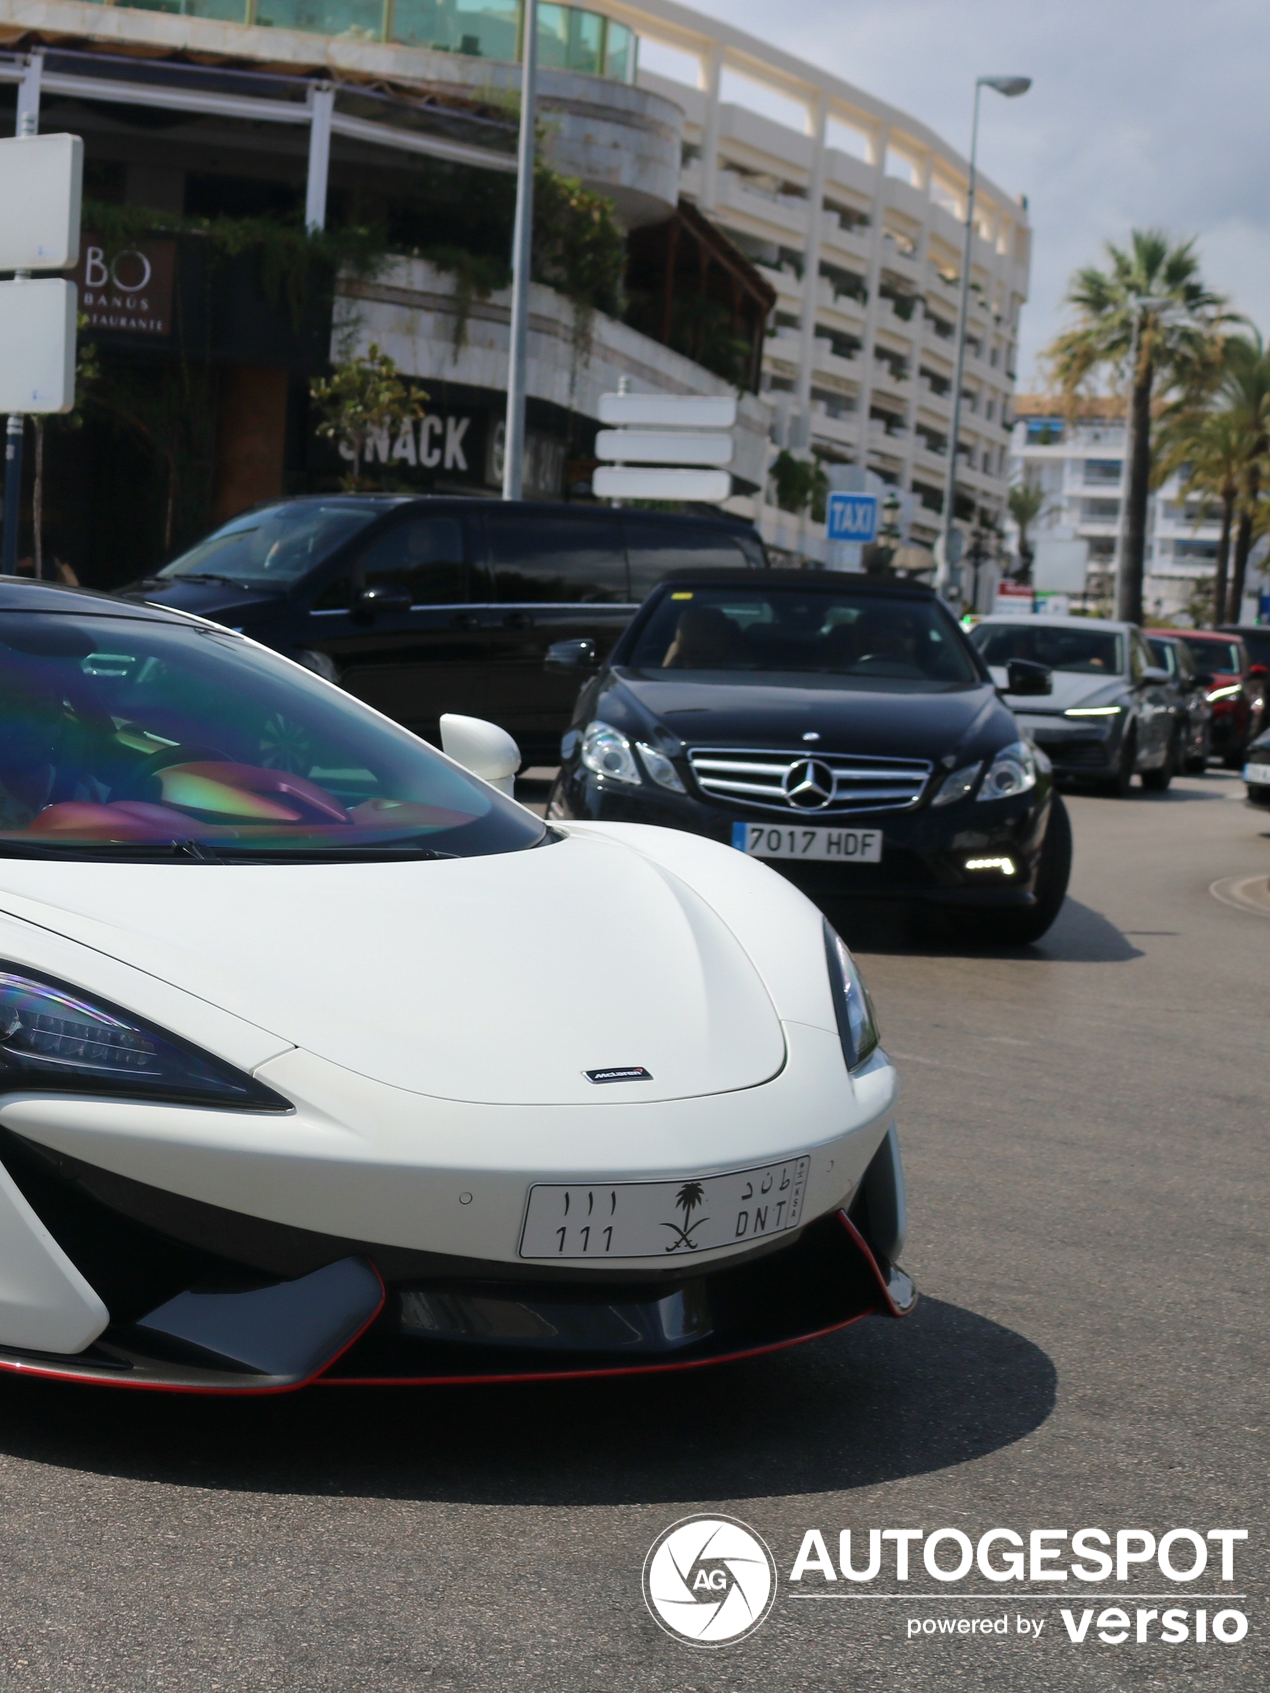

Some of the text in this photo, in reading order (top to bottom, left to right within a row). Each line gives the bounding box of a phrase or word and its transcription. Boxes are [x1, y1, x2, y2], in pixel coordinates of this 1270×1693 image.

[833, 503, 873, 533] TAXI
[750, 828, 876, 857] 7017 HDF
[594, 1070, 643, 1079] McLaren
[735, 1200, 787, 1238] DNT
[555, 1226, 614, 1253] 111
